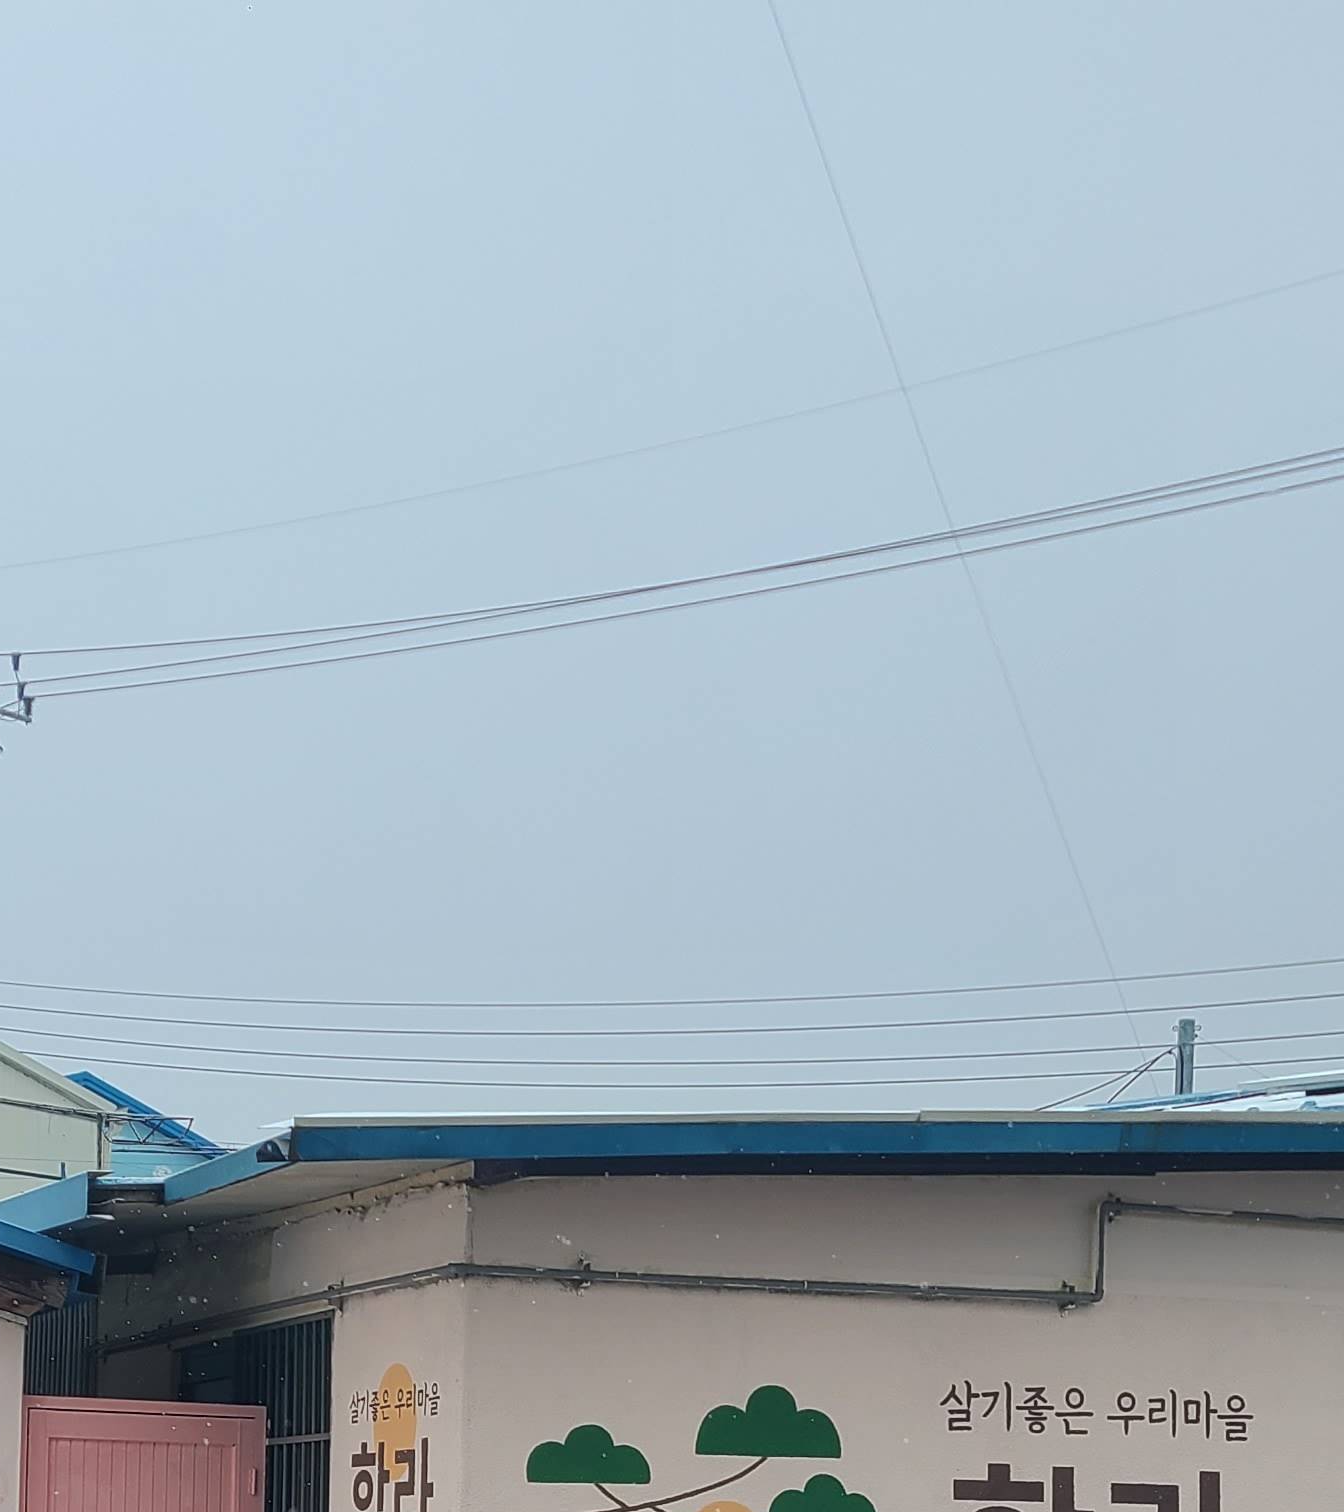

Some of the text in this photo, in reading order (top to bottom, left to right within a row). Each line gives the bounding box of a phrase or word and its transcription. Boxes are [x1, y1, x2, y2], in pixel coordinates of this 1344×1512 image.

[349, 1381, 440, 1425] 살기좋은 우리마을
[939, 1380, 1255, 1442] 살기좋은 우리마을
